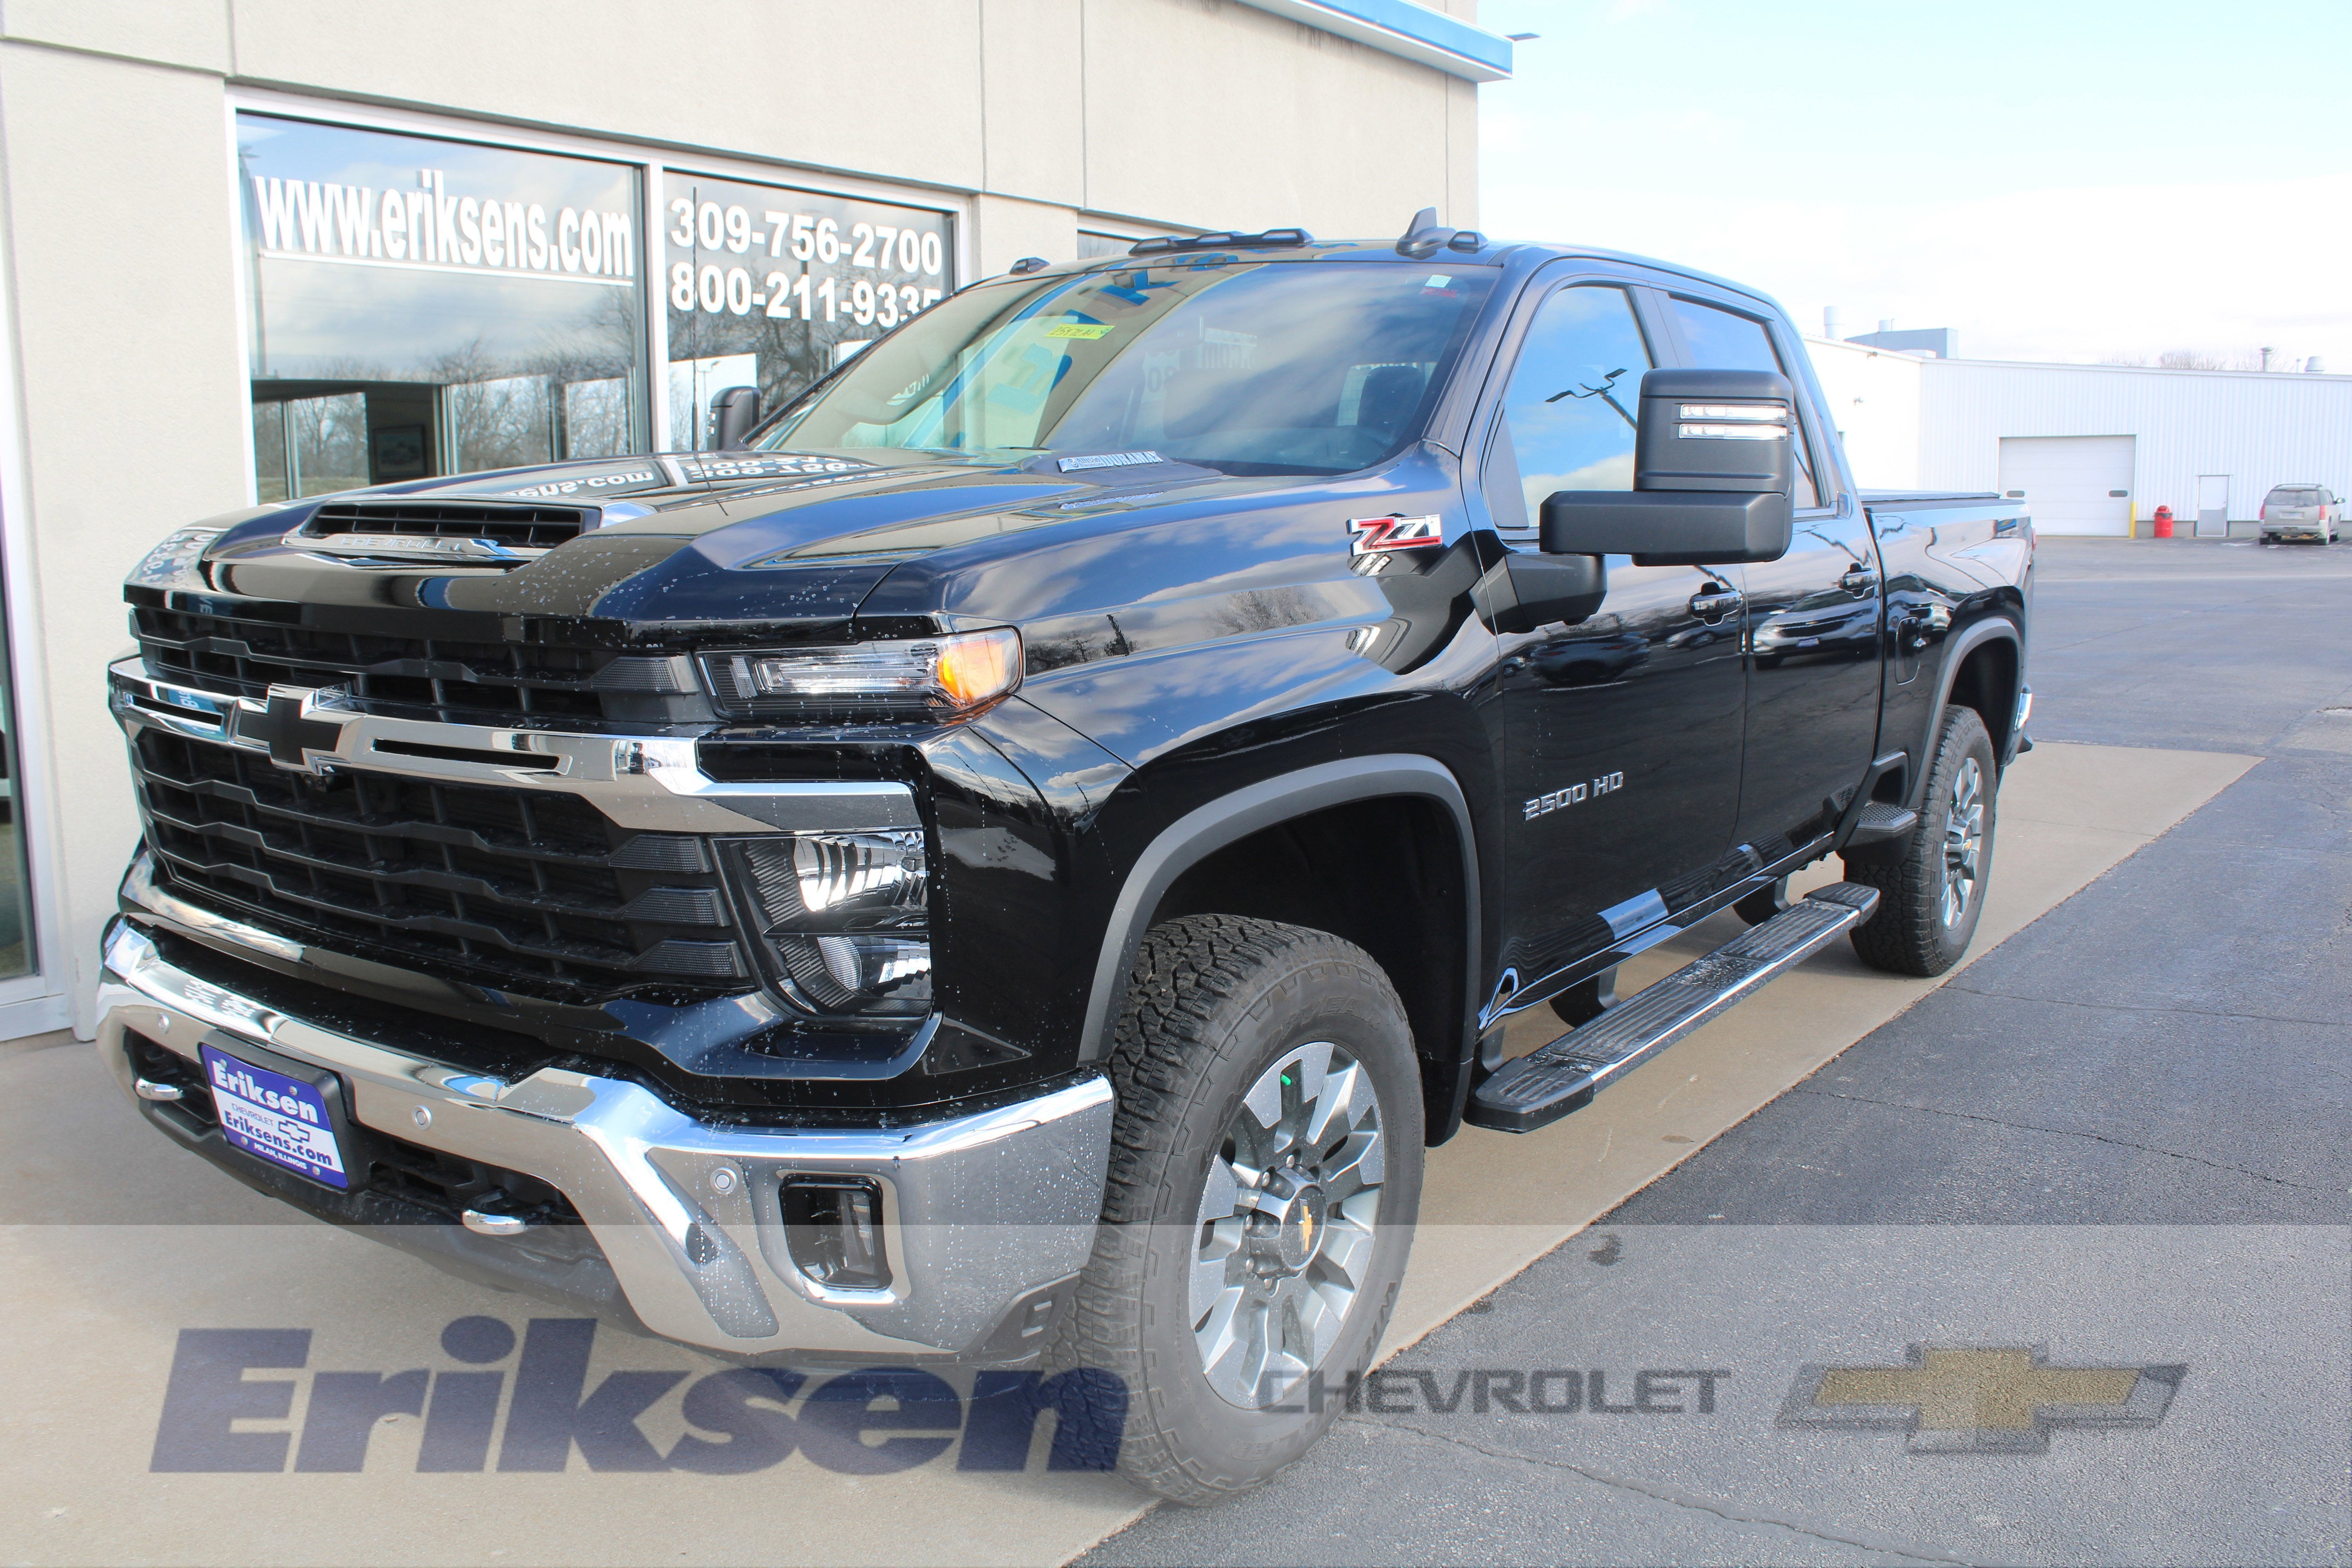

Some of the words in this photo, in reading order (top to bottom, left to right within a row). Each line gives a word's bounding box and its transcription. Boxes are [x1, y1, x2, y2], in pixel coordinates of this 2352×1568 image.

[254, 168, 634, 276] www.eriksens.com
[670, 198, 942, 275] 309-756-2700
[1100, 451, 1164, 468] DURAMAX
[340, 536, 461, 551] CHEVROLET
[1349, 514, 1442, 556] Z71
[1523, 783, 1587, 821] 2500
[1592, 771, 1624, 797] HD
[212, 1060, 319, 1124] Eriksen
[231, 1103, 274, 1127] CHEVROLET
[225, 1110, 333, 1166] Eriksens.com
[254, 1142, 277, 1158] MILAN,
[276, 1152, 307, 1170] ILLINOIS
